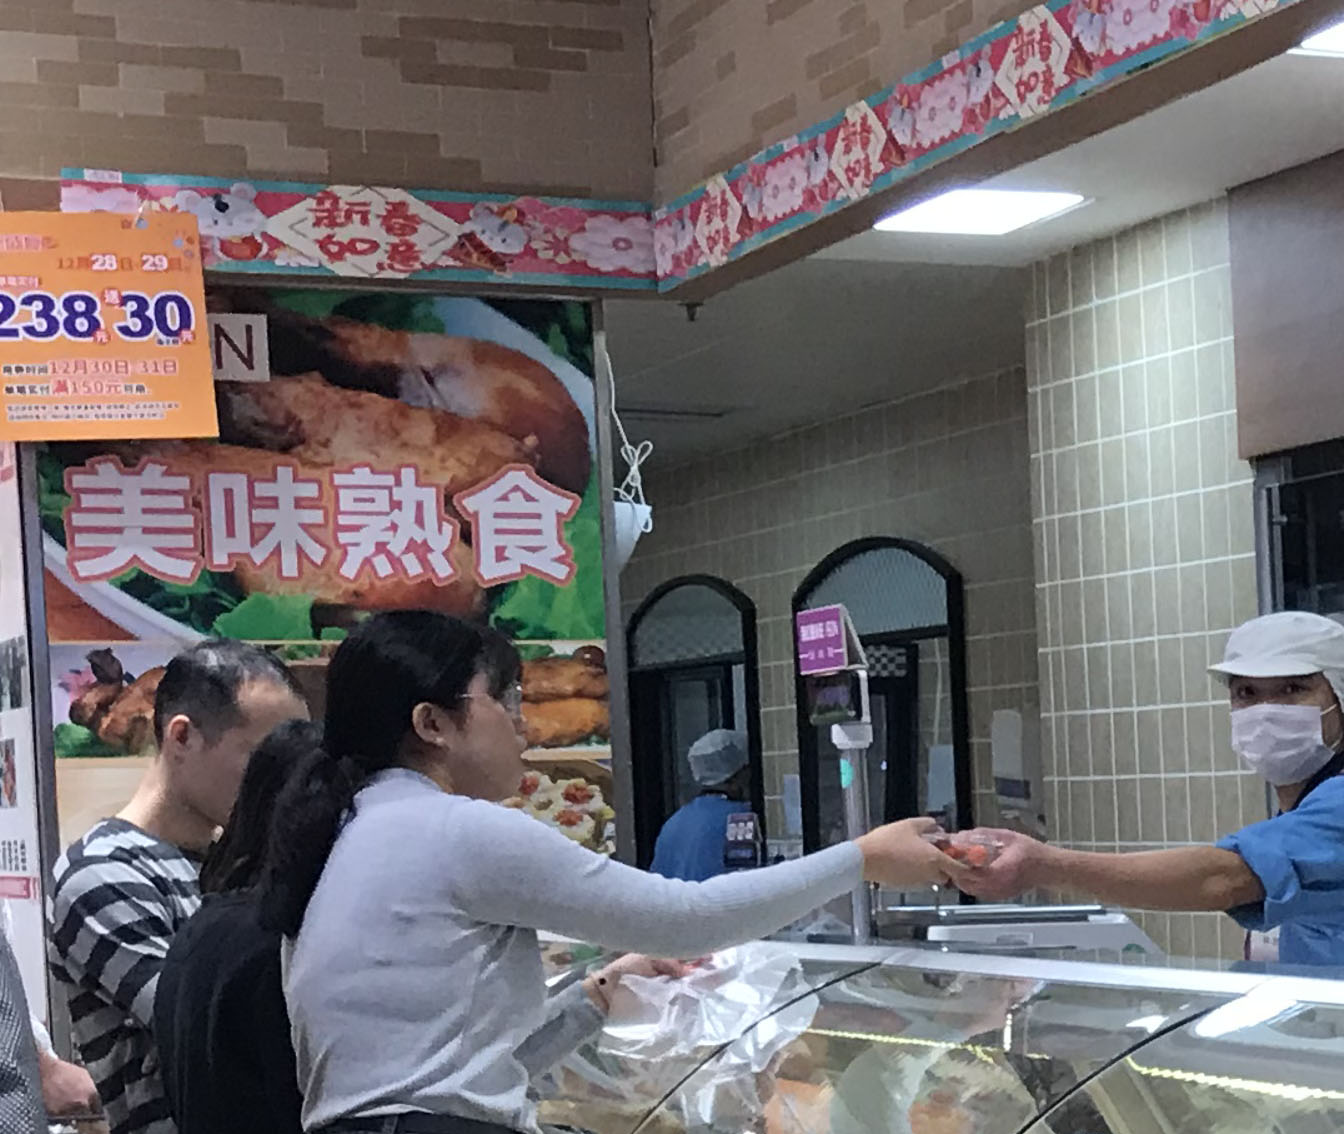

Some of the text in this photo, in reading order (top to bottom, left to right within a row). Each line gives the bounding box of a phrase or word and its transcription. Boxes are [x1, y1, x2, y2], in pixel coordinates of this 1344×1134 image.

[116, 293, 192, 338] 30
[66, 459, 580, 584] 美味熟食
